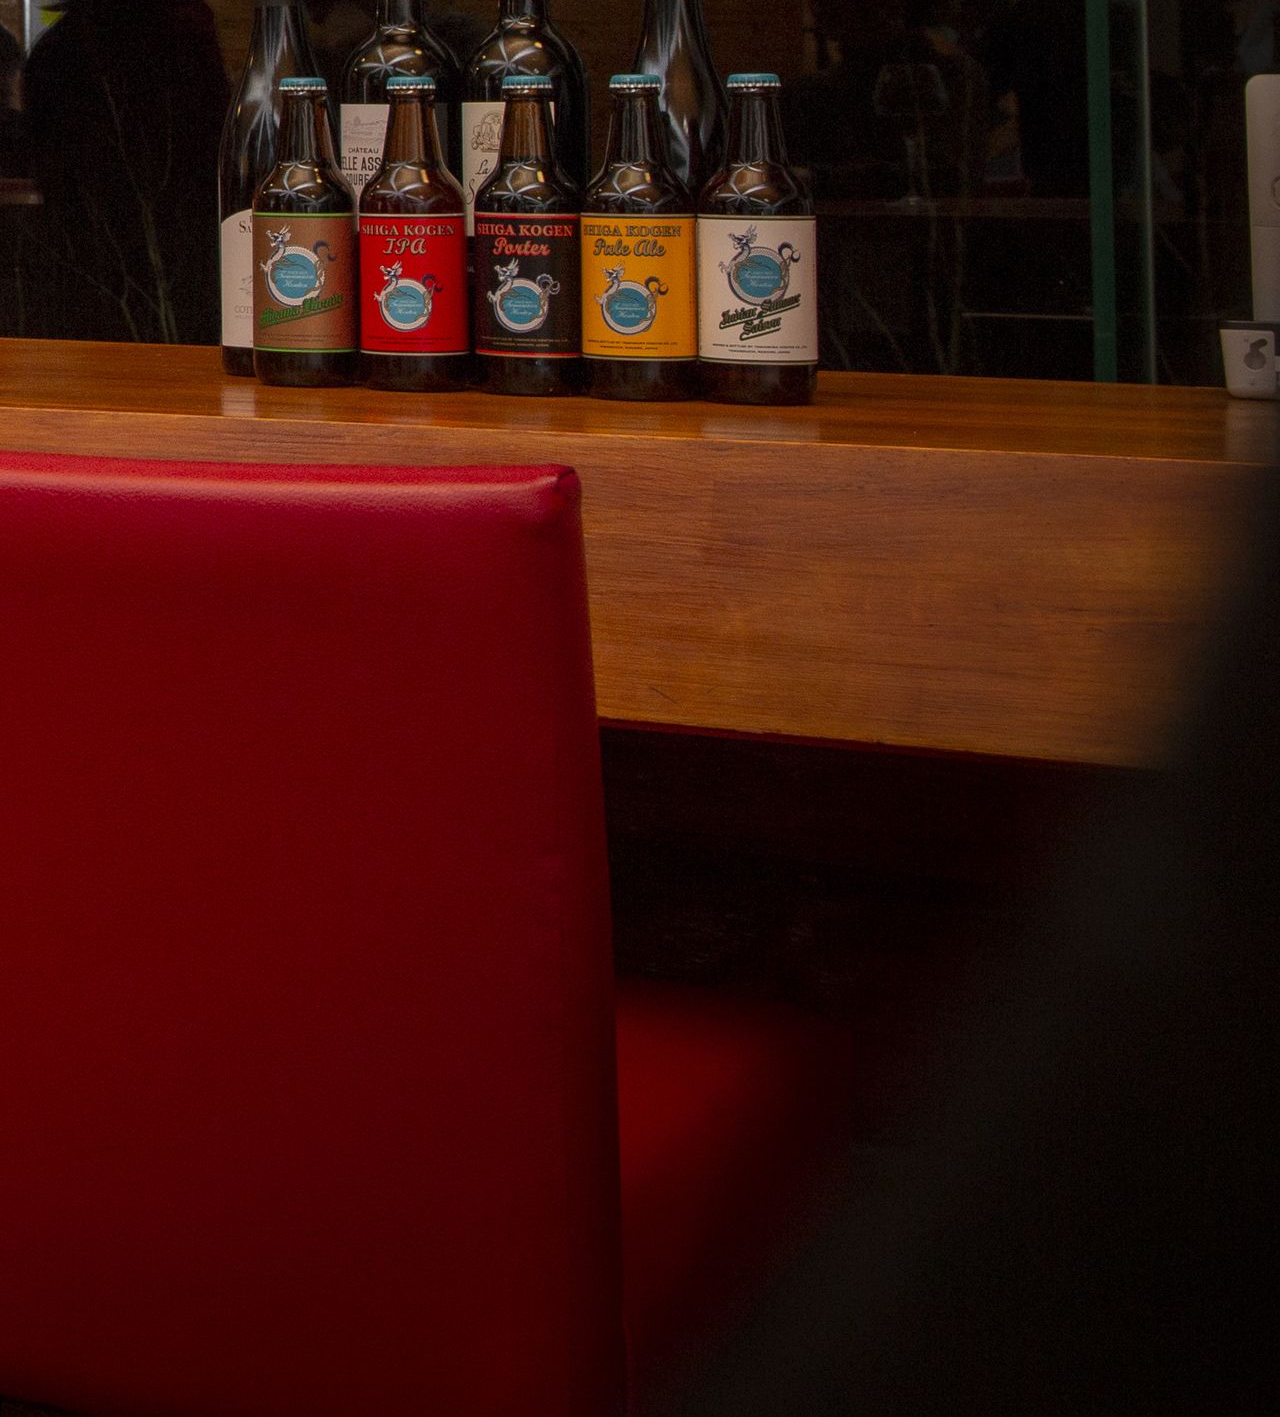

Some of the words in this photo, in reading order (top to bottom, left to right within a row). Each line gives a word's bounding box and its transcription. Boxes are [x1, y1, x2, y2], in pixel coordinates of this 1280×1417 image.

[361, 224, 399, 236] SHIGA
[403, 225, 456, 236] KOGEN
[477, 224, 517, 236] SHIGA
[519, 225, 574, 237] KOGEN
[625, 225, 682, 238] KOGEN
[492, 237, 551, 257] Porter
[593, 238, 631, 256] Pale
[634, 238, 667, 257] Ale
